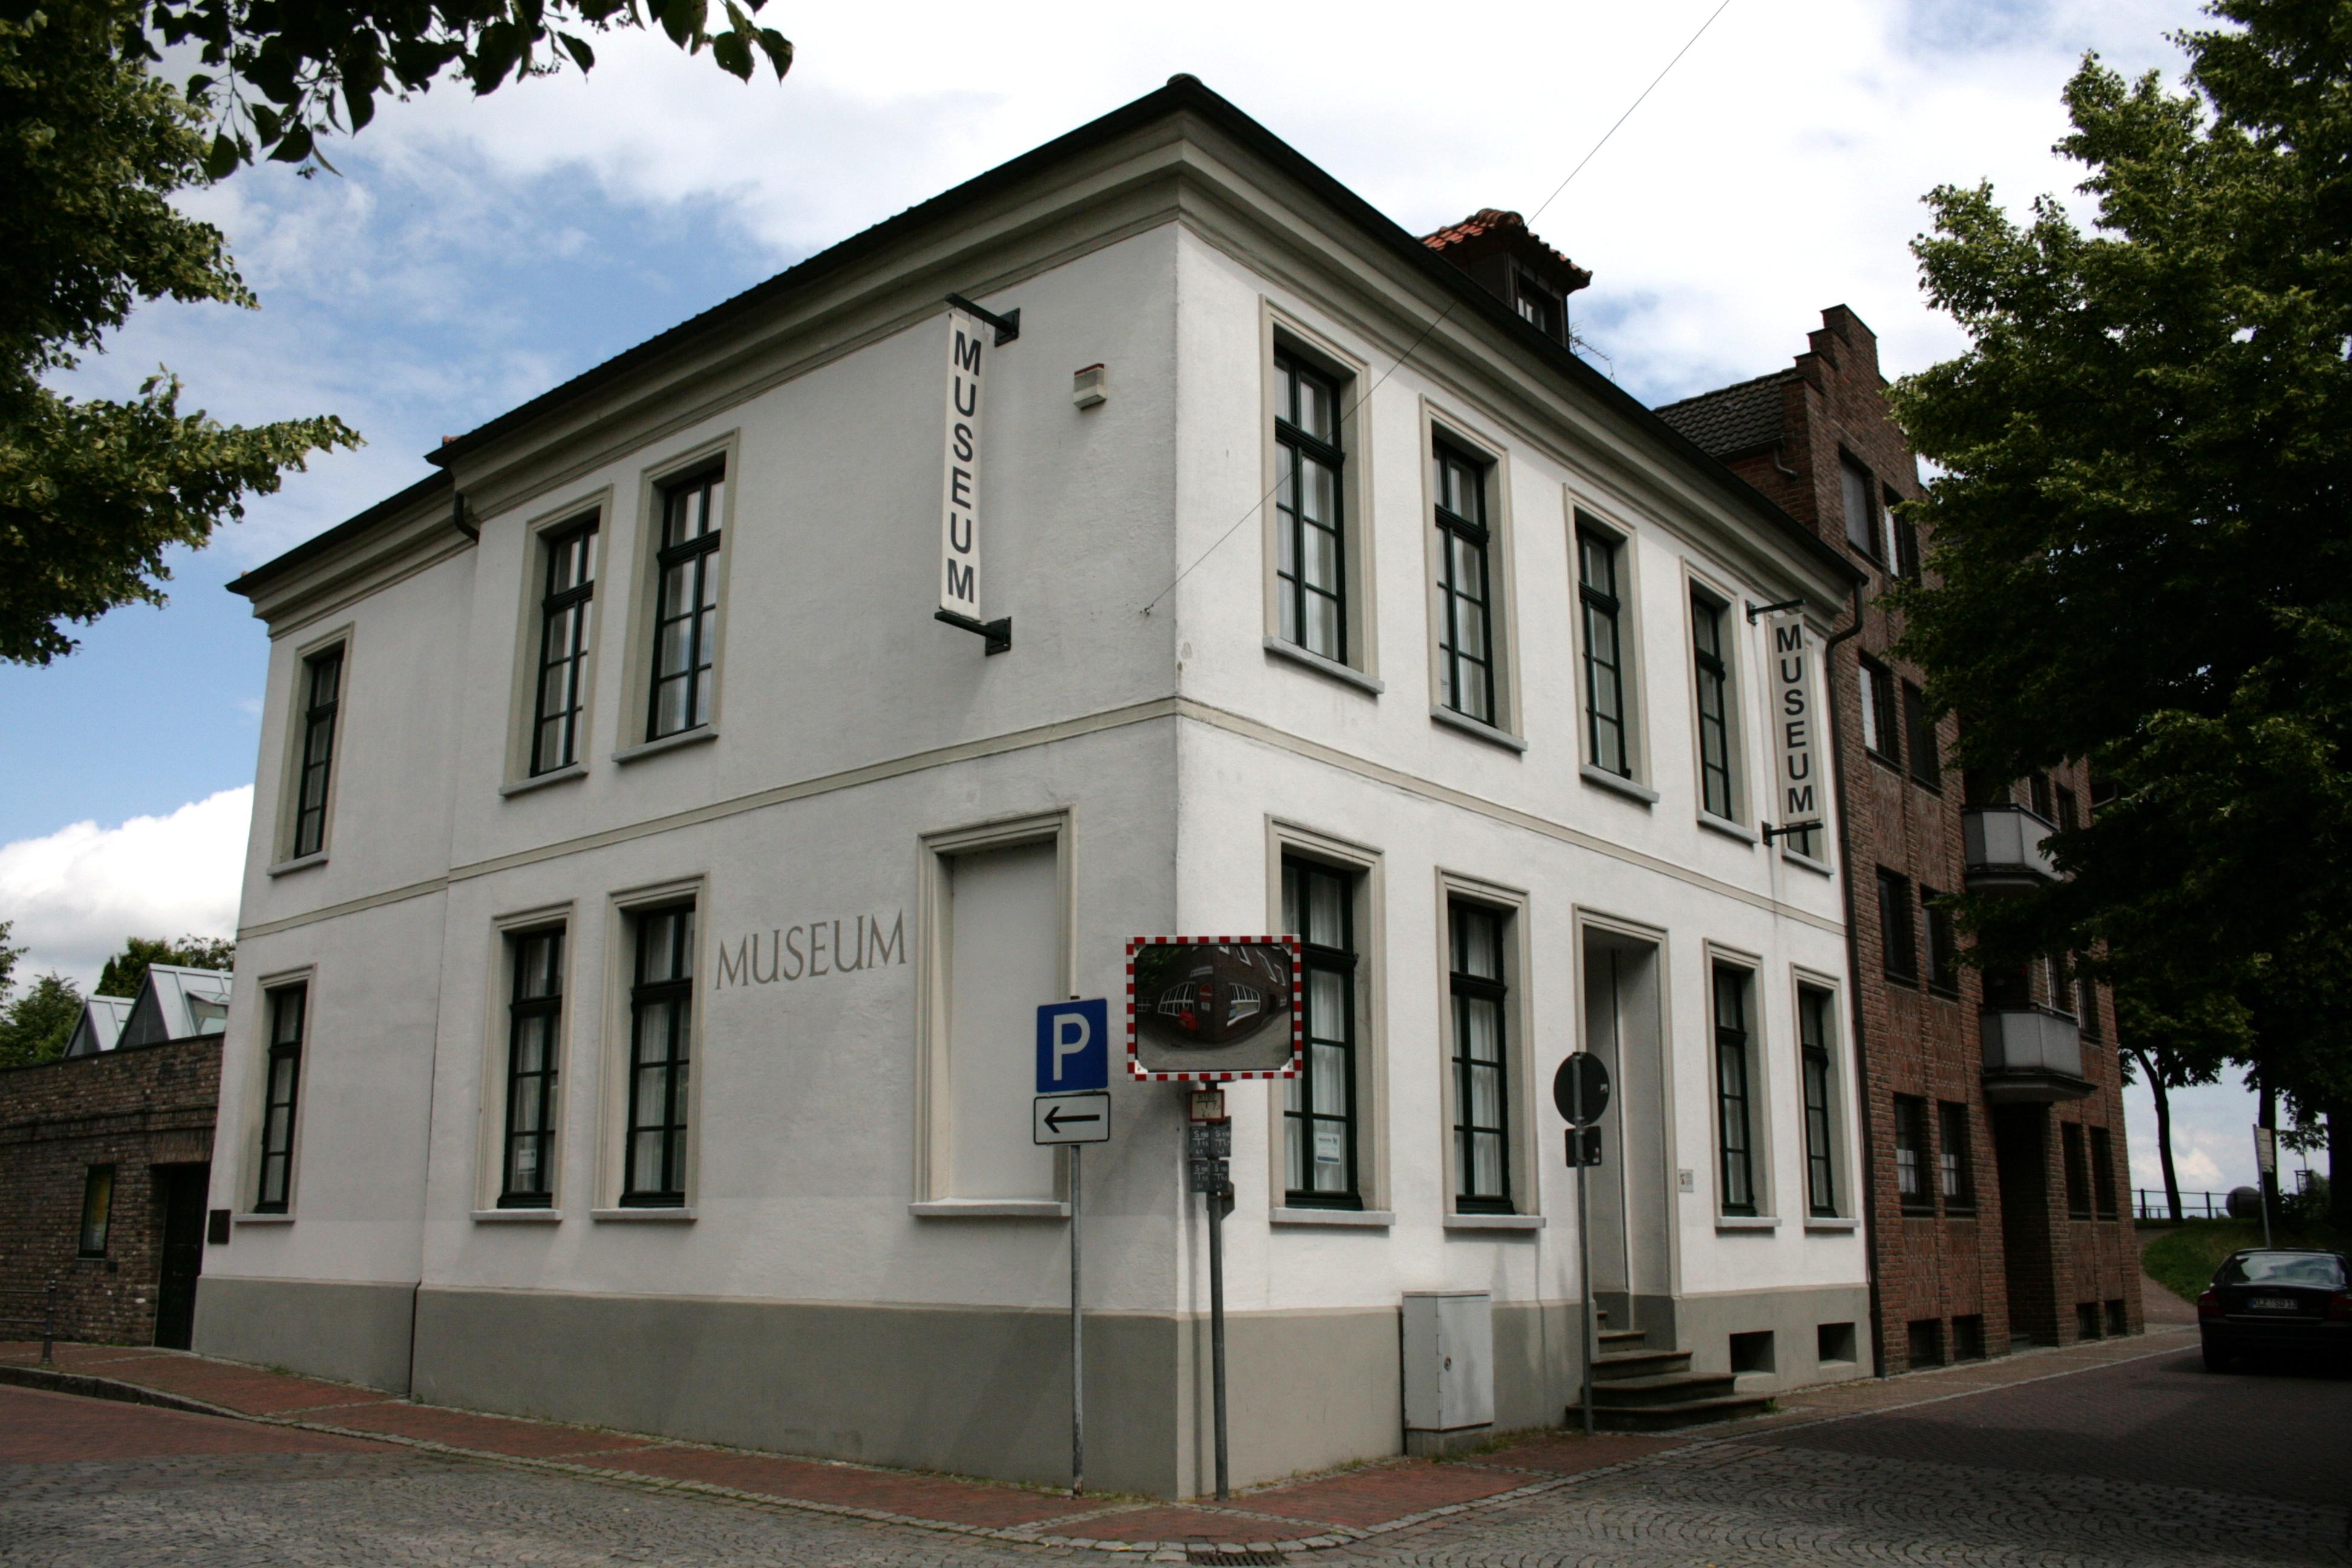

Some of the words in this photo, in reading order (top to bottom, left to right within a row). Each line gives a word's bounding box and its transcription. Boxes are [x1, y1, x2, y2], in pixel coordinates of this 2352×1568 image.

[947, 330, 982, 604] MUSEUM
[1776, 624, 1813, 814] MUSEUM
[714, 907, 907, 990] MUSEUM
[1053, 1012, 1091, 1081] P
